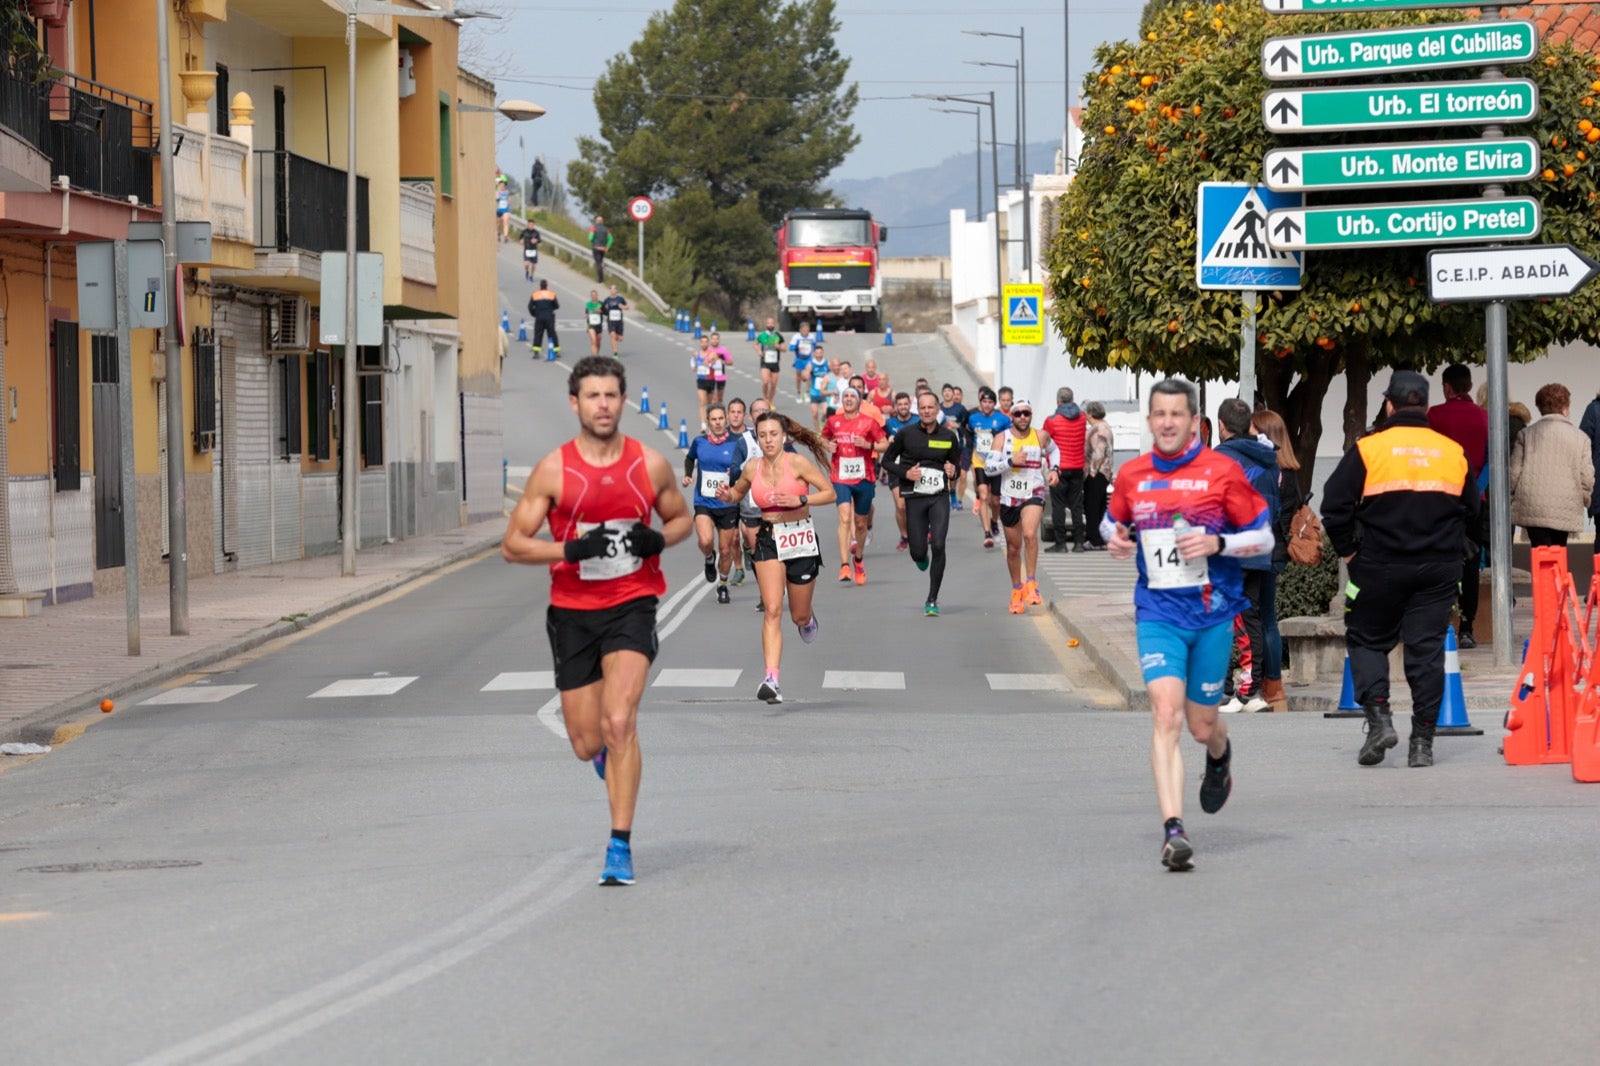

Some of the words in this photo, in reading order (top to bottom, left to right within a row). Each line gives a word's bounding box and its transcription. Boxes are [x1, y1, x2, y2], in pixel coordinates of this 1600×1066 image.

[1307, 45, 1344, 65] Urb.
[1350, 40, 1412, 66] Parque
[1417, 36, 1446, 57] del
[1450, 31, 1522, 55] Cubillas
[1368, 95, 1412, 116] Urb.
[1420, 93, 1439, 113] El
[1446, 90, 1522, 112] torreón
[1340, 156, 1384, 177] Urb.
[1392, 152, 1458, 174] Monte
[1465, 149, 1522, 171] Elvira
[634, 204, 648, 213] 30
[1337, 215, 1380, 236] Urb.
[1387, 212, 1456, 236] Cortijo
[1463, 207, 1525, 230] Pretel
[1436, 268, 1493, 283] C.E.I.P.
[1501, 260, 1569, 280] ABADÍA
[844, 464, 861, 473] 322
[706, 479, 724, 489] 69
[920, 475, 939, 486] 645
[1010, 480, 1028, 490] 381
[1171, 479, 1209, 492] SEUR
[779, 529, 814, 549] 2076
[1154, 547, 1189, 568] 14
